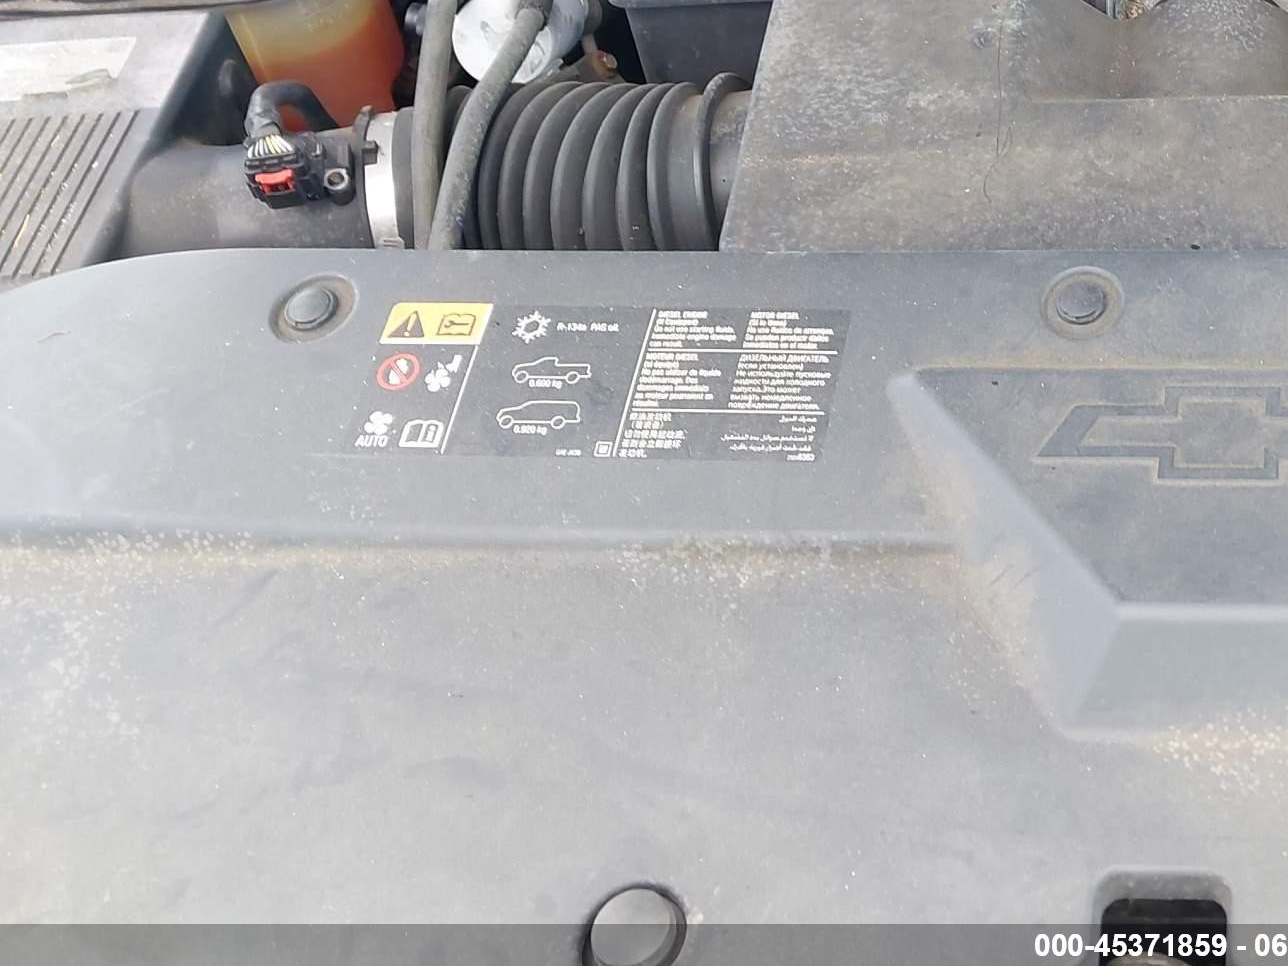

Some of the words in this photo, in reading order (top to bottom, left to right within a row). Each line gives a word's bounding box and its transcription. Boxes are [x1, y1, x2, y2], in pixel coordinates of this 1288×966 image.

[552, 379, 562, 389] kg
[537, 426, 548, 435] kg
[354, 434, 388, 447] AUTO
